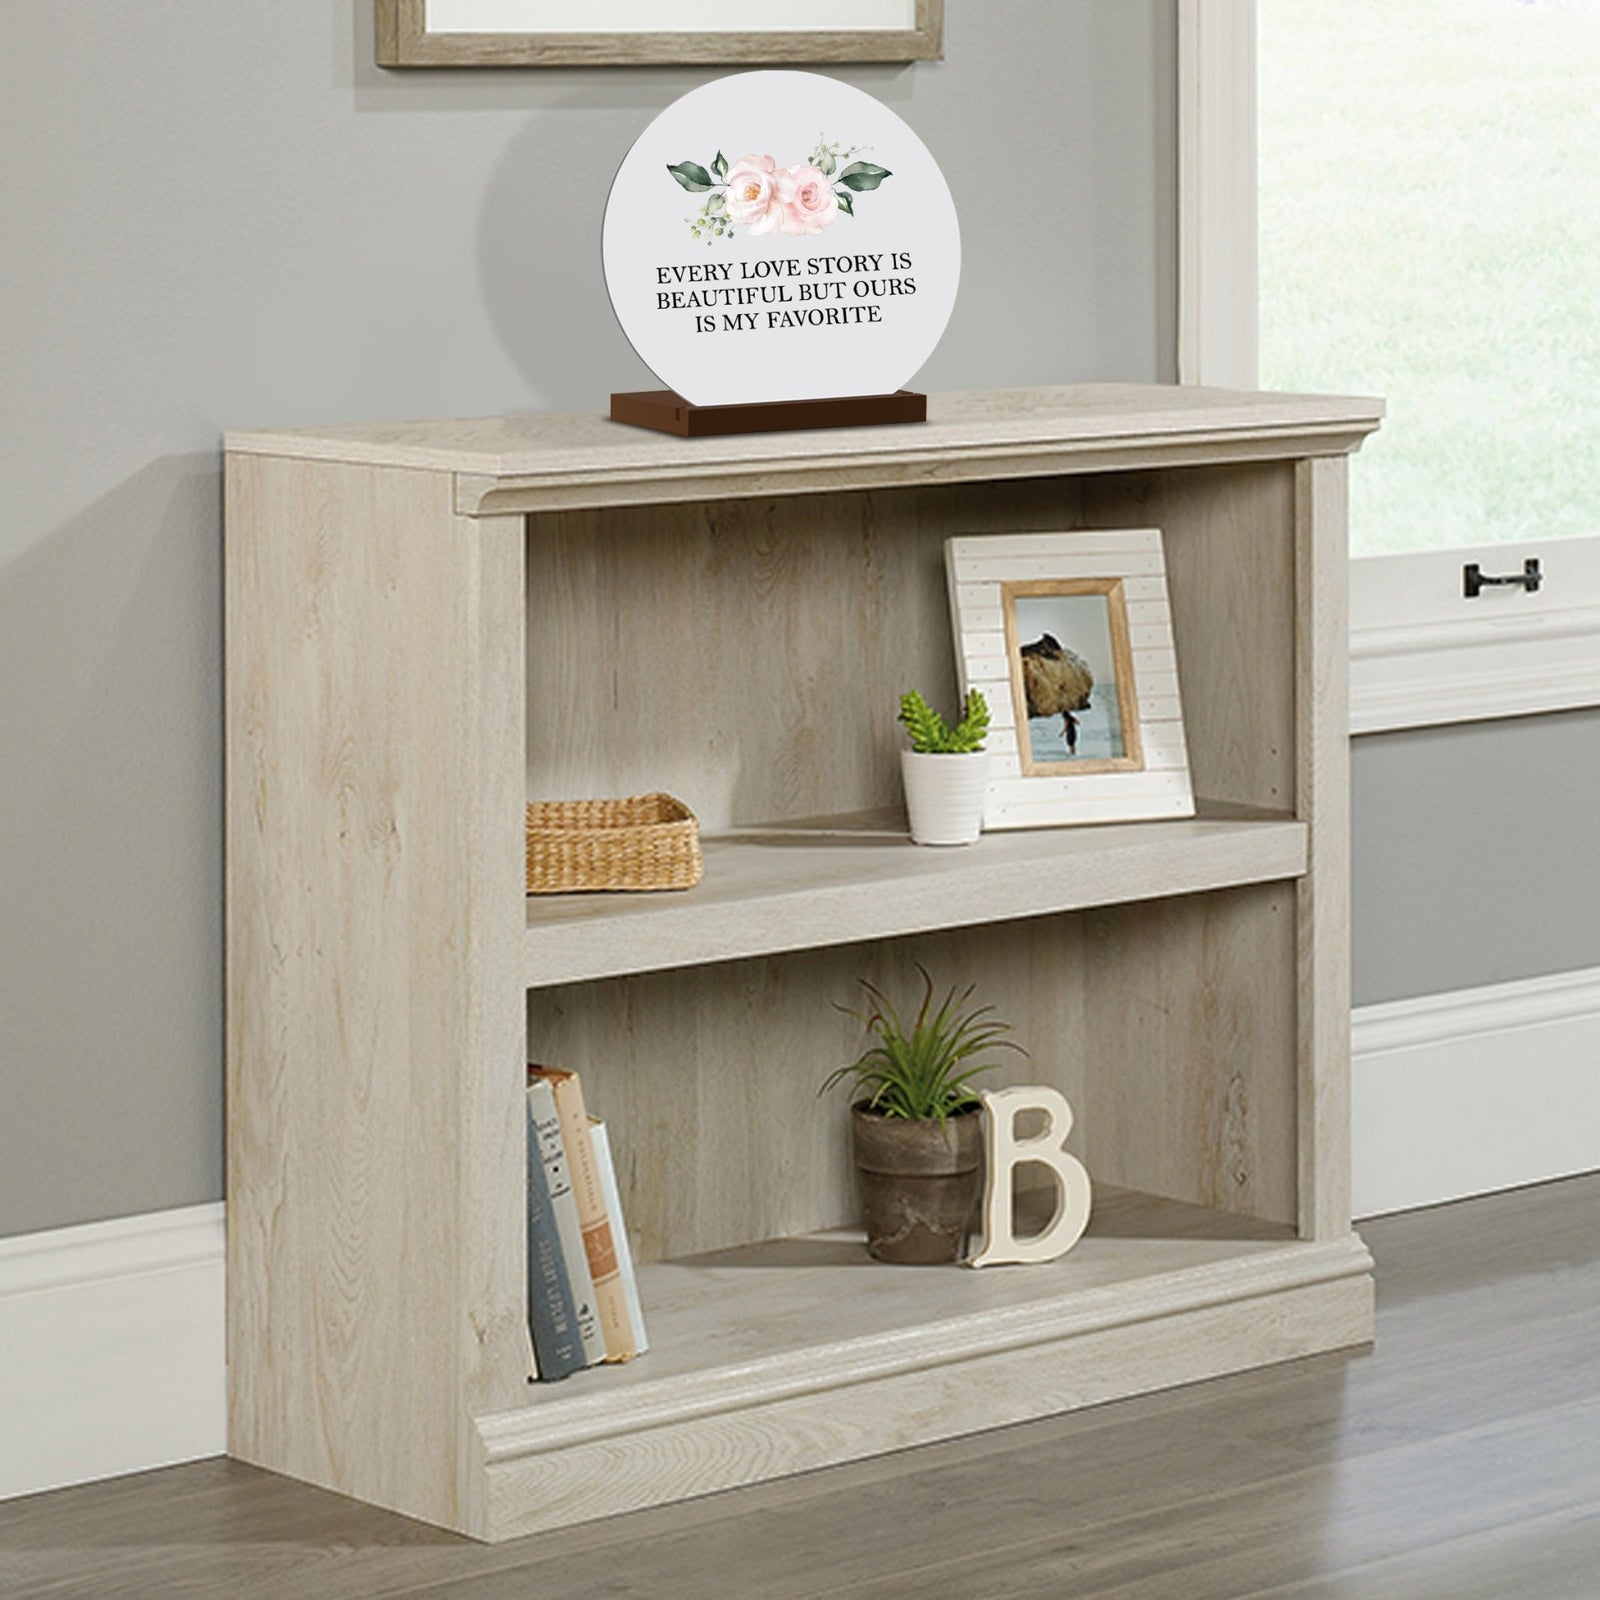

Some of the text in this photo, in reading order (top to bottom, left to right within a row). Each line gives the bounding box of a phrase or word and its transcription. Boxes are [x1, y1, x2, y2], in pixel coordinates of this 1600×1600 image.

[656, 252, 912, 284] EVERY LOVE STORY IS
[656, 277, 917, 310] BEAUTIFUL BUT OURS
[695, 305, 882, 333] IS MY FAVORITE
[966, 1085, 1093, 1269] B
